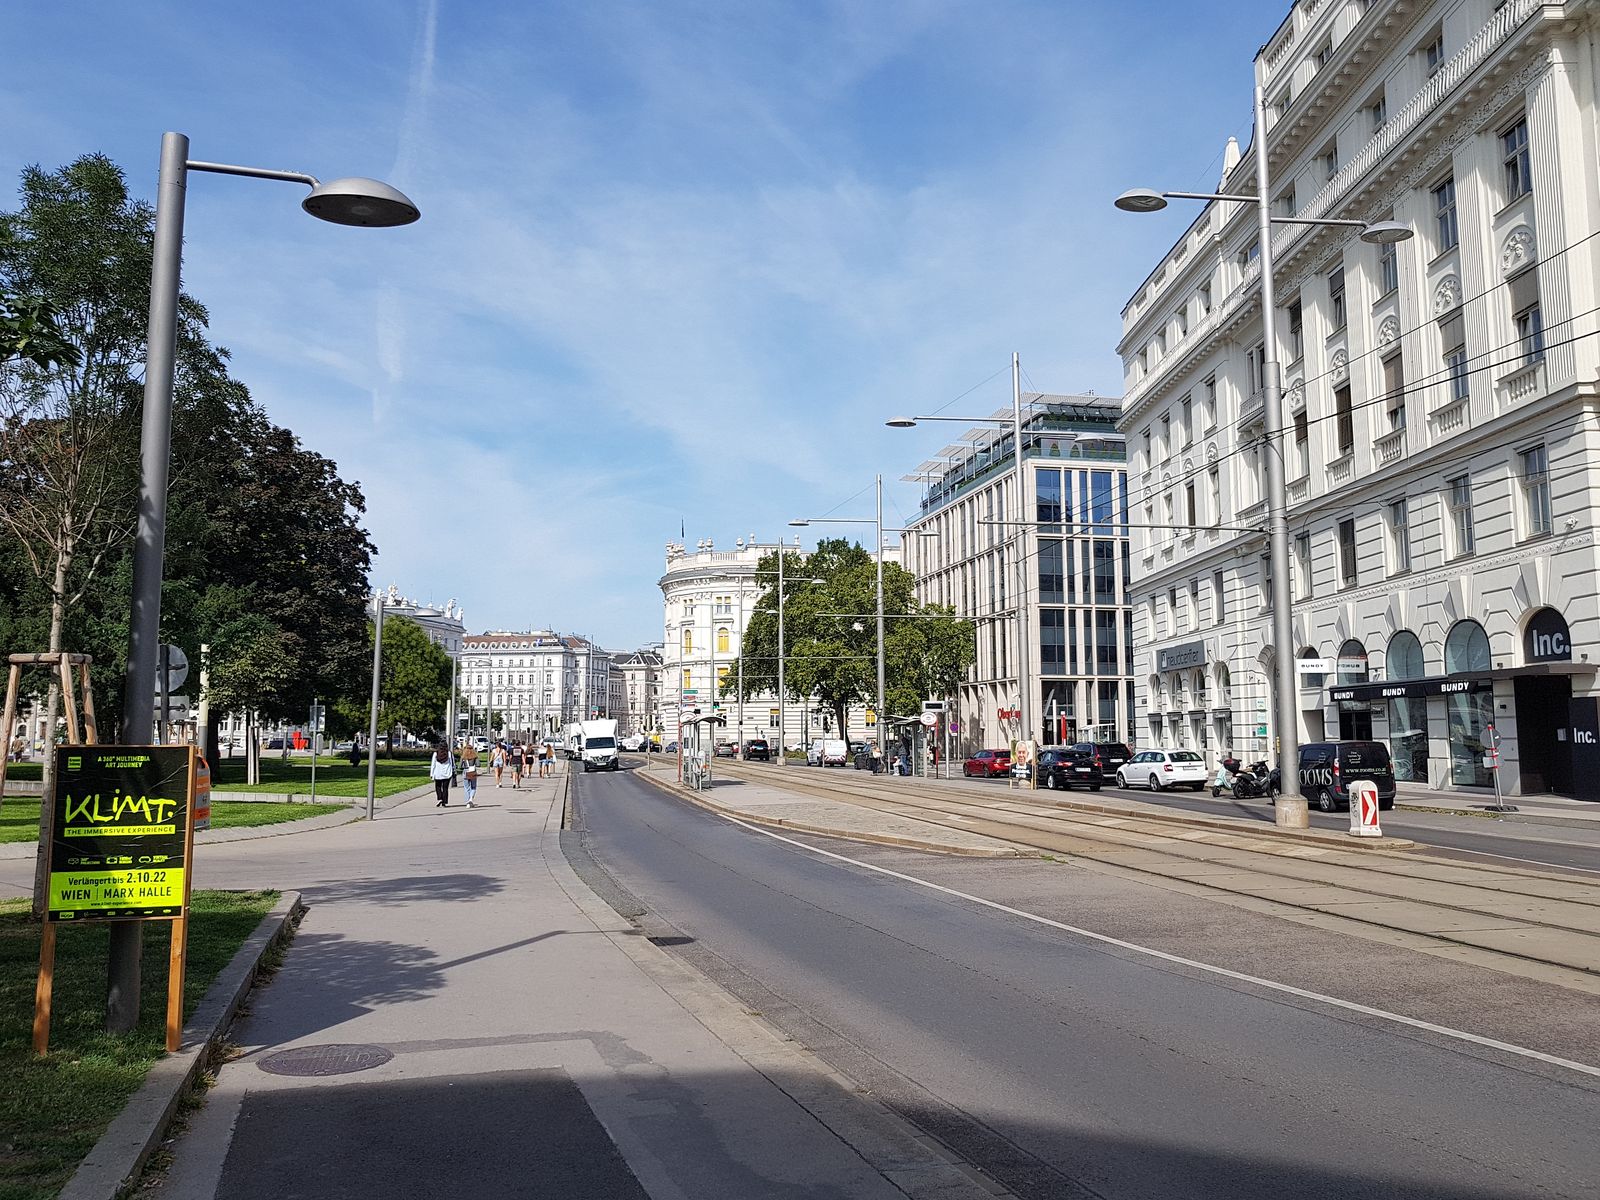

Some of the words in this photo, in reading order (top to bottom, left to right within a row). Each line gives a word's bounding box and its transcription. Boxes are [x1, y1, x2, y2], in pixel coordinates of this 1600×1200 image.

[1532, 629, 1571, 658] Inc.
[1382, 687, 1406, 697] BUNDY
[1441, 681, 1470, 692] BUNDY
[1334, 692, 1354, 700] BUNDY
[1573, 728, 1597, 744] Inc.
[127, 826, 173, 834] EXPERIENCE
[68, 876, 111, 887] Verlängert
[112, 876, 124, 884] bis
[126, 871, 166, 884] 2.10.22
[61, 889, 91, 901] WIEN
[104, 888, 134, 899] MARX
[139, 886, 172, 897] HALLE
